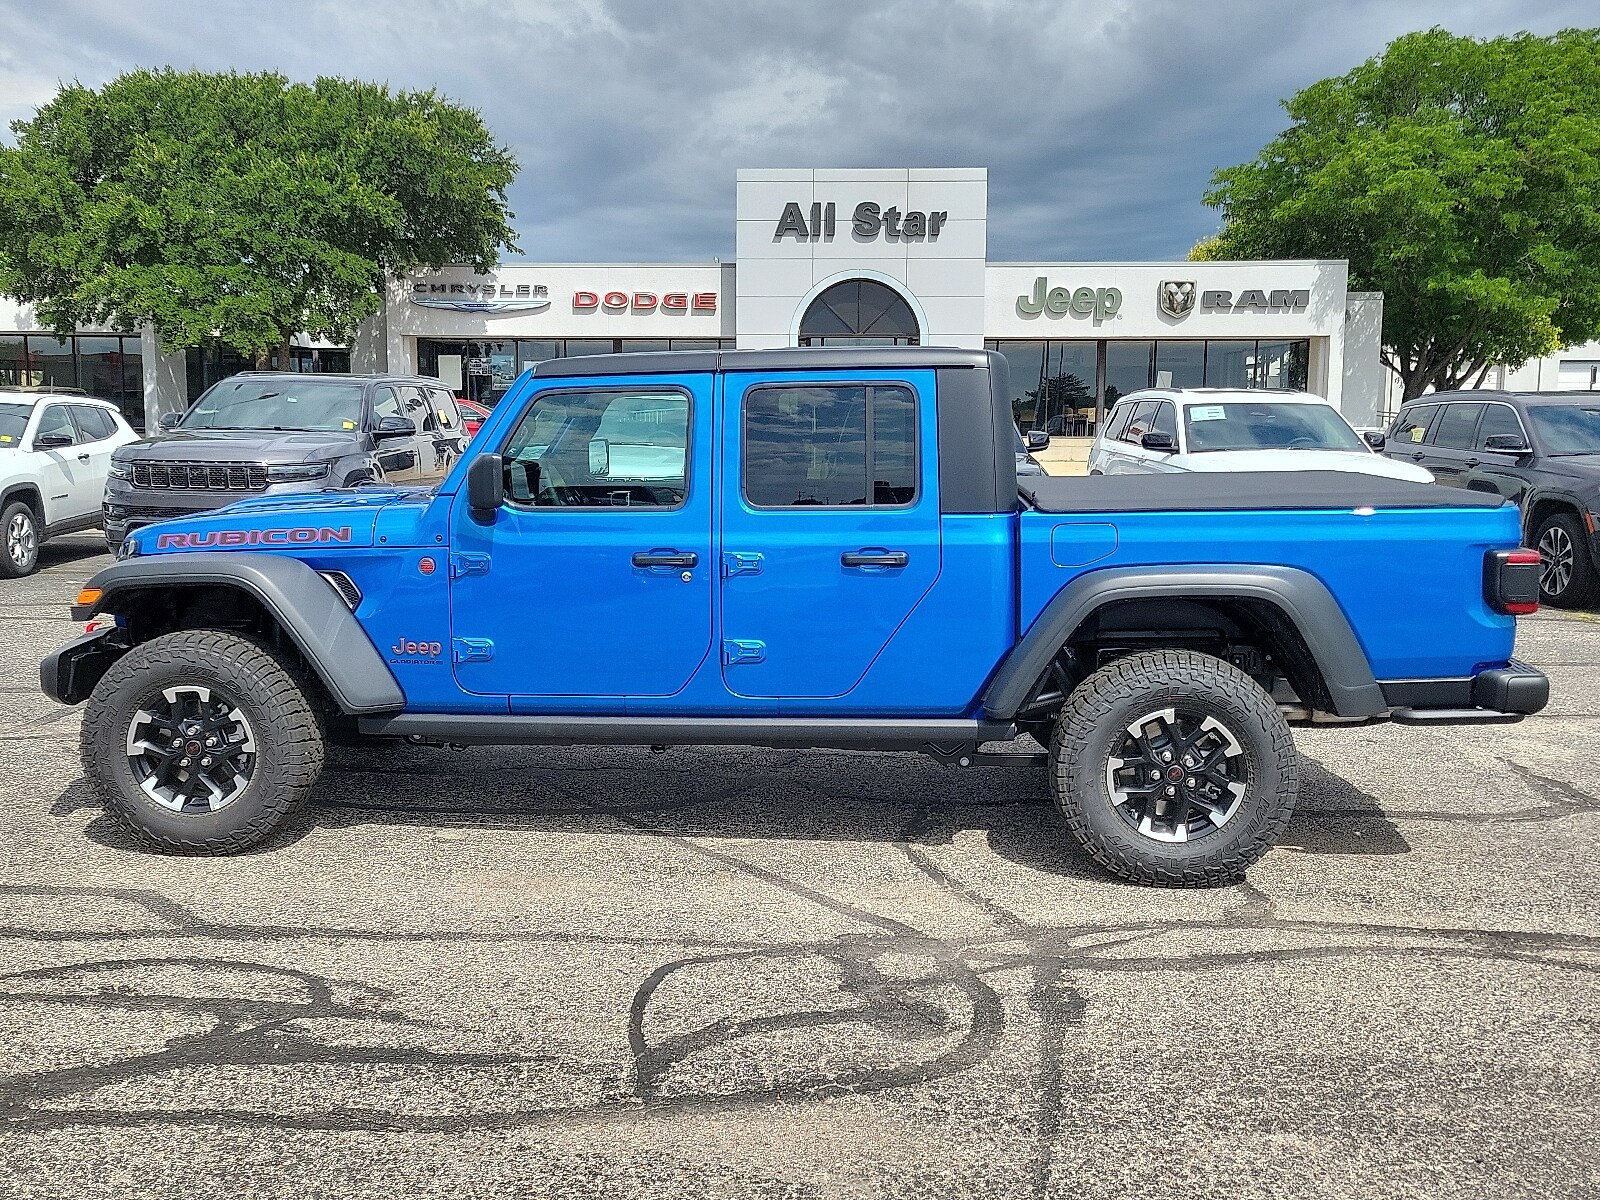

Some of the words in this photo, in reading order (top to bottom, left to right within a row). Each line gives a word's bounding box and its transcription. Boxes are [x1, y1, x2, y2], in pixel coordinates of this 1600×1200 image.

[775, 202, 836, 237] All
[854, 201, 948, 238] Star
[413, 284, 549, 297] CHRYSLER
[573, 291, 718, 311] DODGE
[1016, 276, 1122, 321] Jeep
[1202, 290, 1310, 309] RAM
[157, 527, 351, 549] RUBICON
[391, 637, 443, 659] Jeep
